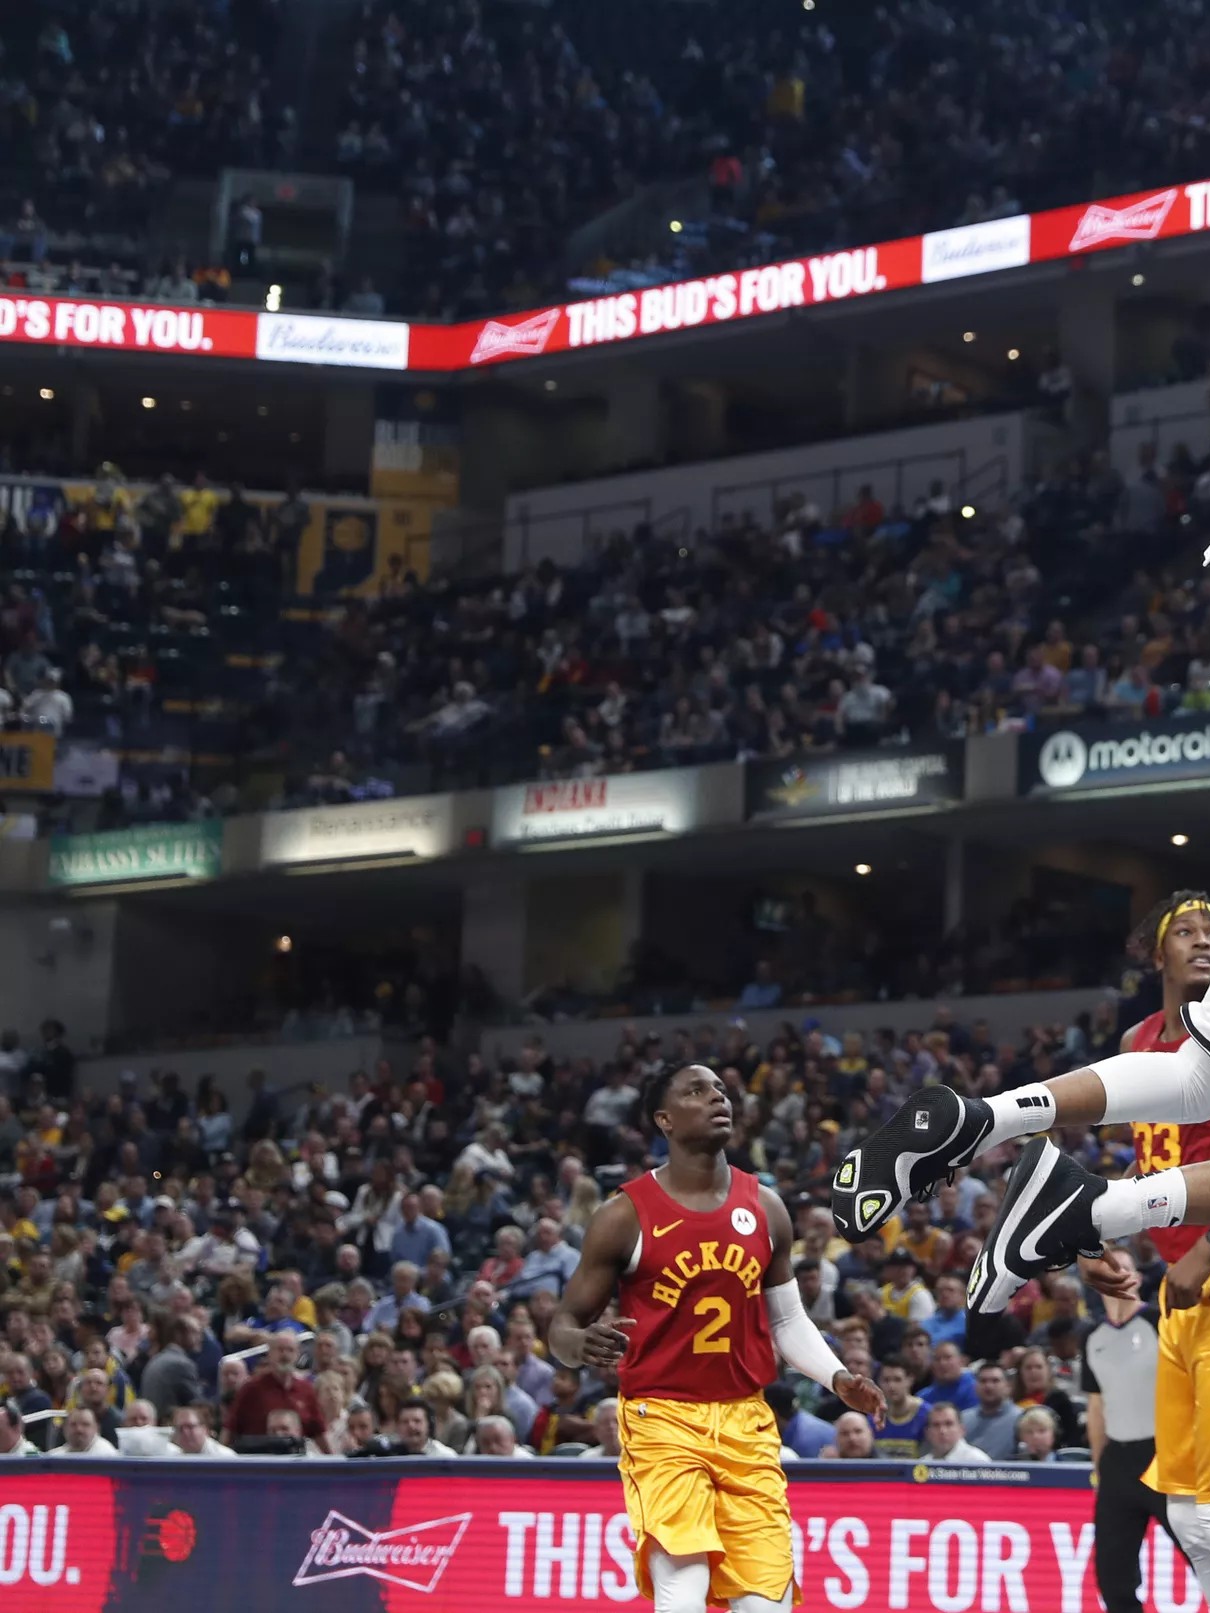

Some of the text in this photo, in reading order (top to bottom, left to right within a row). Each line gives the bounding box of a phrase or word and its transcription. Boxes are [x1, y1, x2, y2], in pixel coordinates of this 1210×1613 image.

[566, 246, 888, 347] THIS BUD'S FOR YOU.
[54, 303, 127, 345] FOR
[131, 308, 214, 352] YOU.
[1129, 1121, 1181, 1174] 33
[693, 1296, 731, 1354] 2
[311, 1526, 454, 1566] Budweiser
[498, 1511, 641, 1602] THIS
[888, 1519, 1031, 1613] FOR
